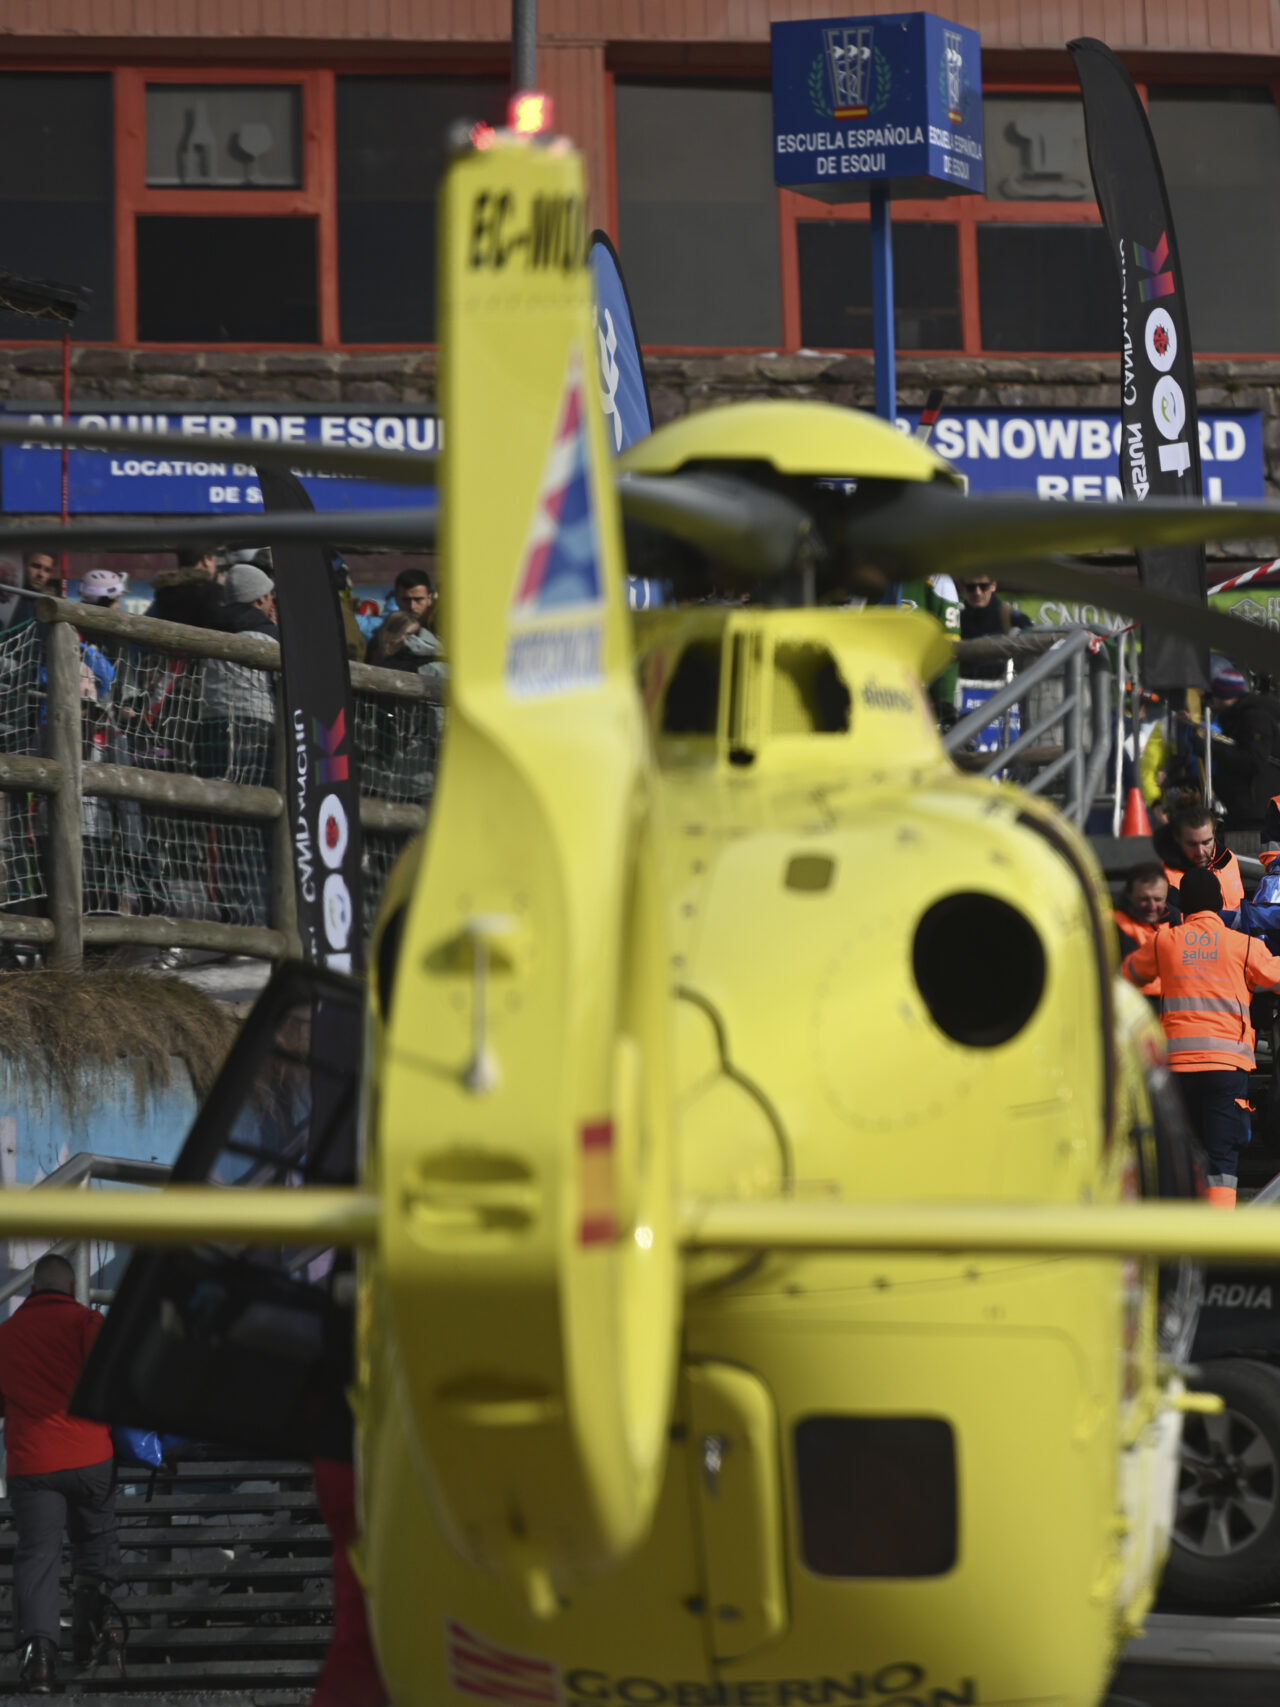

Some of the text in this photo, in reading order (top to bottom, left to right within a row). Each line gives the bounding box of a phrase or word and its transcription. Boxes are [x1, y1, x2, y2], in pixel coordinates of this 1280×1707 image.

[777, 124, 924, 153] ESCUELA ESPAÑOLA
[817, 153, 886, 175] DE ESQUI
[250, 417, 306, 448] DE
[934, 418, 1246, 462] SNOWBRD
[110, 460, 227, 477] LOCATION
[209, 486, 239, 504] DE
[1184, 931, 1219, 947] 061
[1182, 947, 1218, 960] salud
